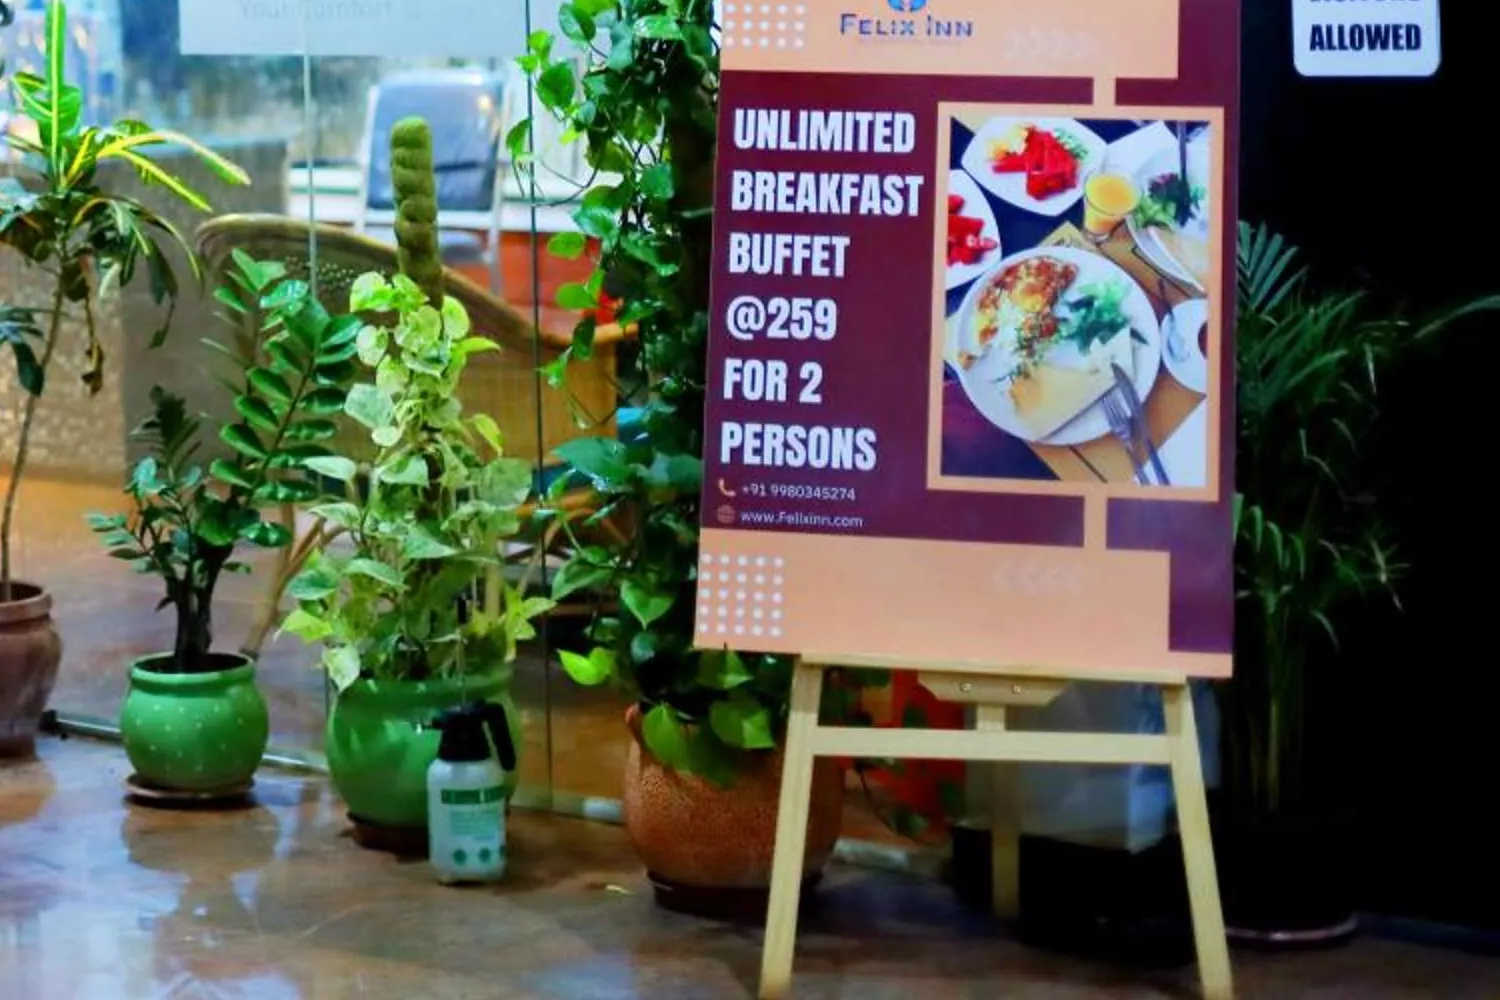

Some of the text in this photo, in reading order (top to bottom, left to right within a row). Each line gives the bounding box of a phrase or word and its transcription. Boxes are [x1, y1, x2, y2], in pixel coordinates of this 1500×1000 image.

[840, 12, 973, 37] FELIX INN
[1309, 24, 1422, 51] ALLOWED
[733, 108, 917, 154] UNLIMITED
[731, 170, 925, 218] BREAKFAST
[728, 231, 851, 278] BUFFET
[726, 295, 838, 342] @259
[722, 357, 823, 404] FOR 2
[720, 422, 878, 472] PERSONS
[742, 482, 857, 501] +91 9980345274
[740, 510, 864, 528] www.Felixinn.com
